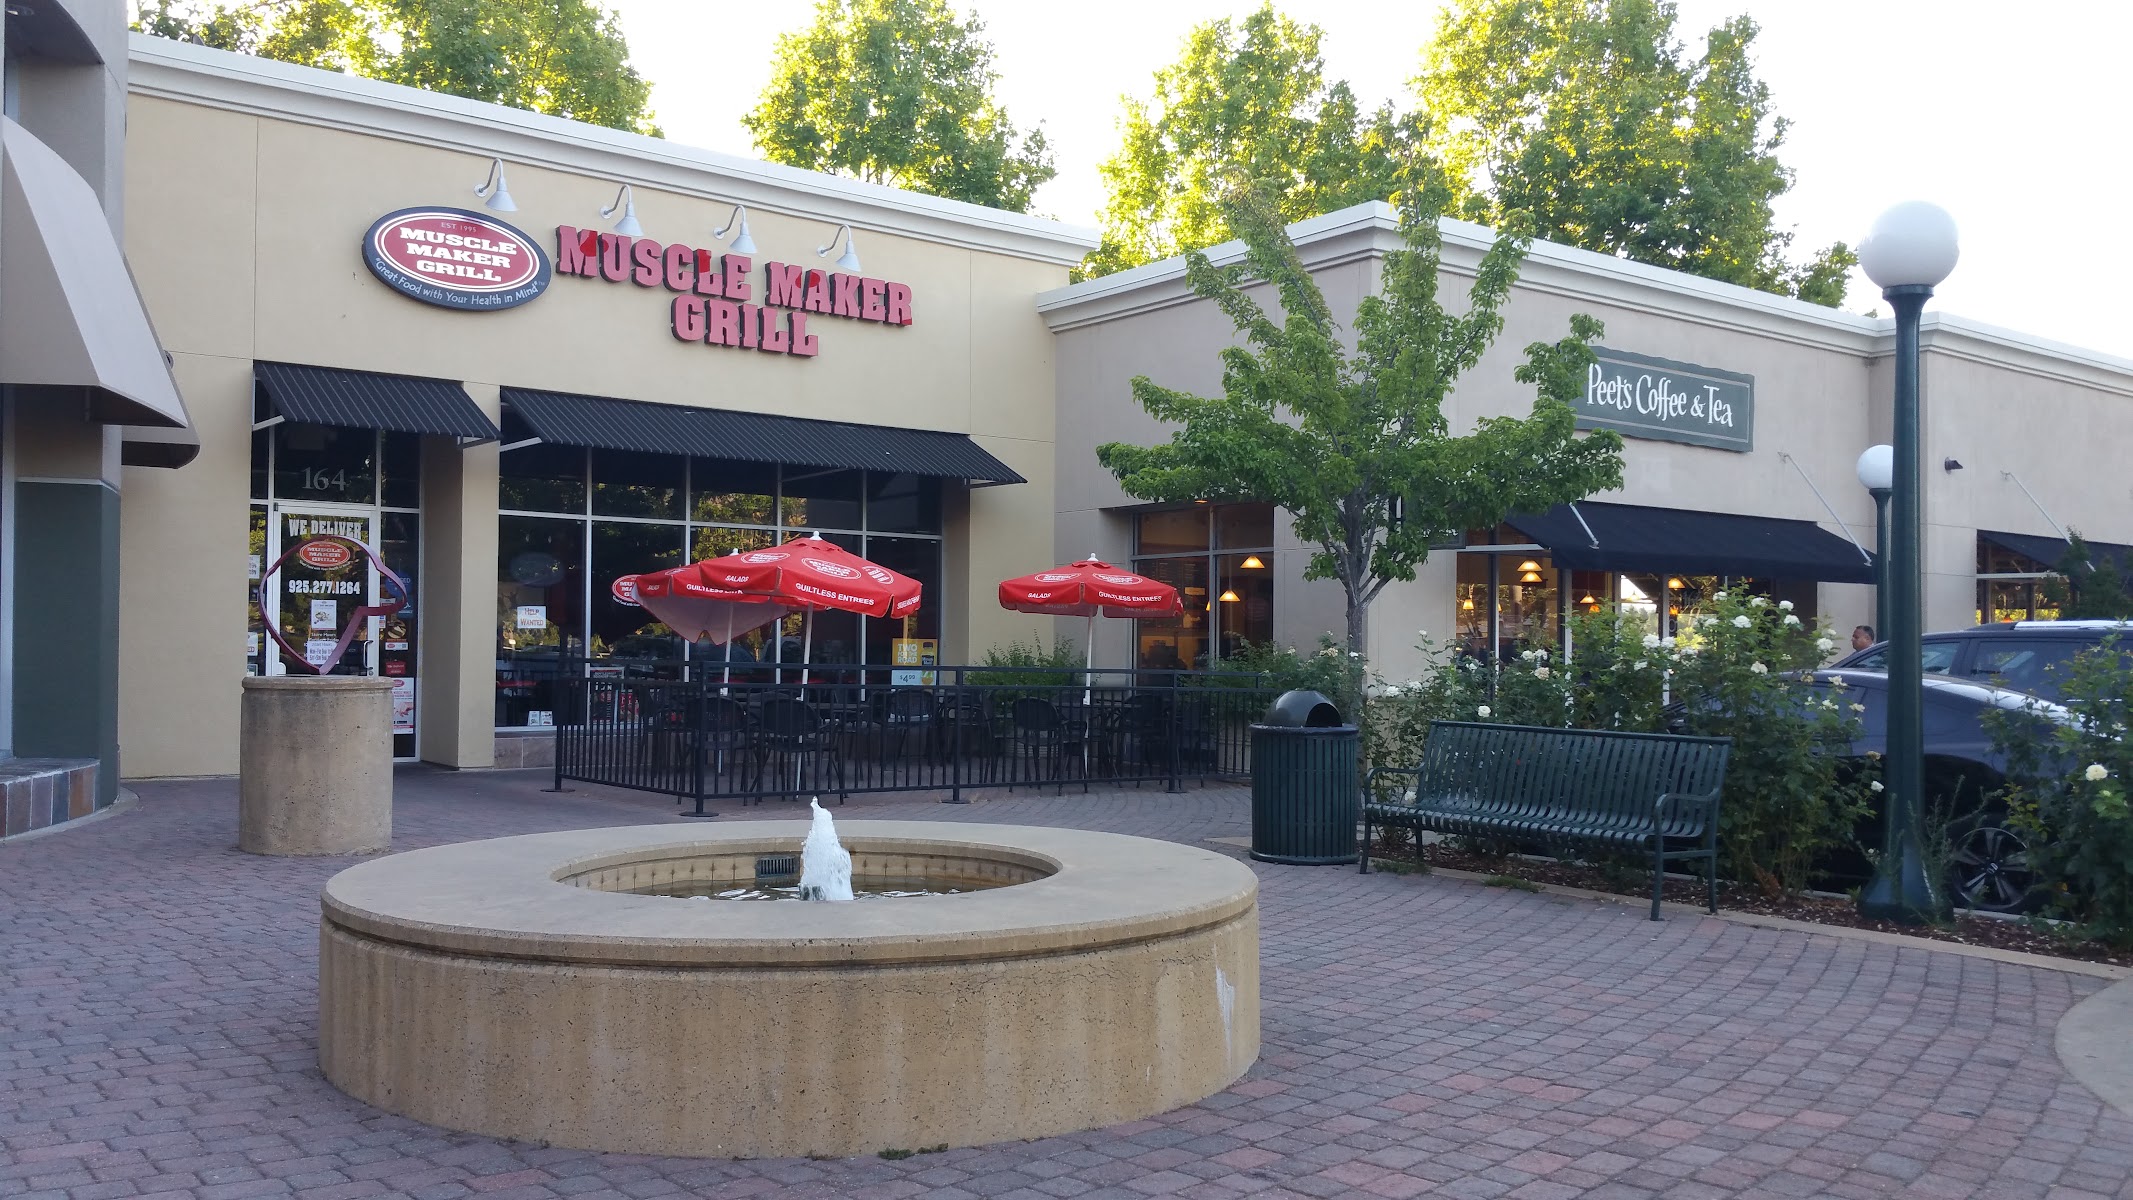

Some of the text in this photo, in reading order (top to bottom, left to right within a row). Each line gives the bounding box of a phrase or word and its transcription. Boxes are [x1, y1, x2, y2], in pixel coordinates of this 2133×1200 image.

[400, 227, 517, 255] MUSCLE
[461, 225, 477, 233] 1995
[406, 243, 511, 268] MAKER
[416, 259, 502, 282] GRILL
[555, 225, 912, 327] MUSCLE MAKER
[398, 276, 422, 294] Food
[423, 288, 443, 300] with
[446, 291, 468, 304] Your
[471, 294, 502, 306] Health
[504, 295, 513, 303] in
[671, 295, 818, 357] GRILL
[1587, 362, 1733, 427] Peet's Coffee & Tea
[301, 466, 346, 491] 164
[289, 519, 362, 540] WE DELIVER
[288, 580, 361, 594] 925.277.1264
[725, 575, 749, 583] SALADS
[796, 583, 875, 606] GUILTLESS ENTREES
[897, 656, 918, 664] ROAD
